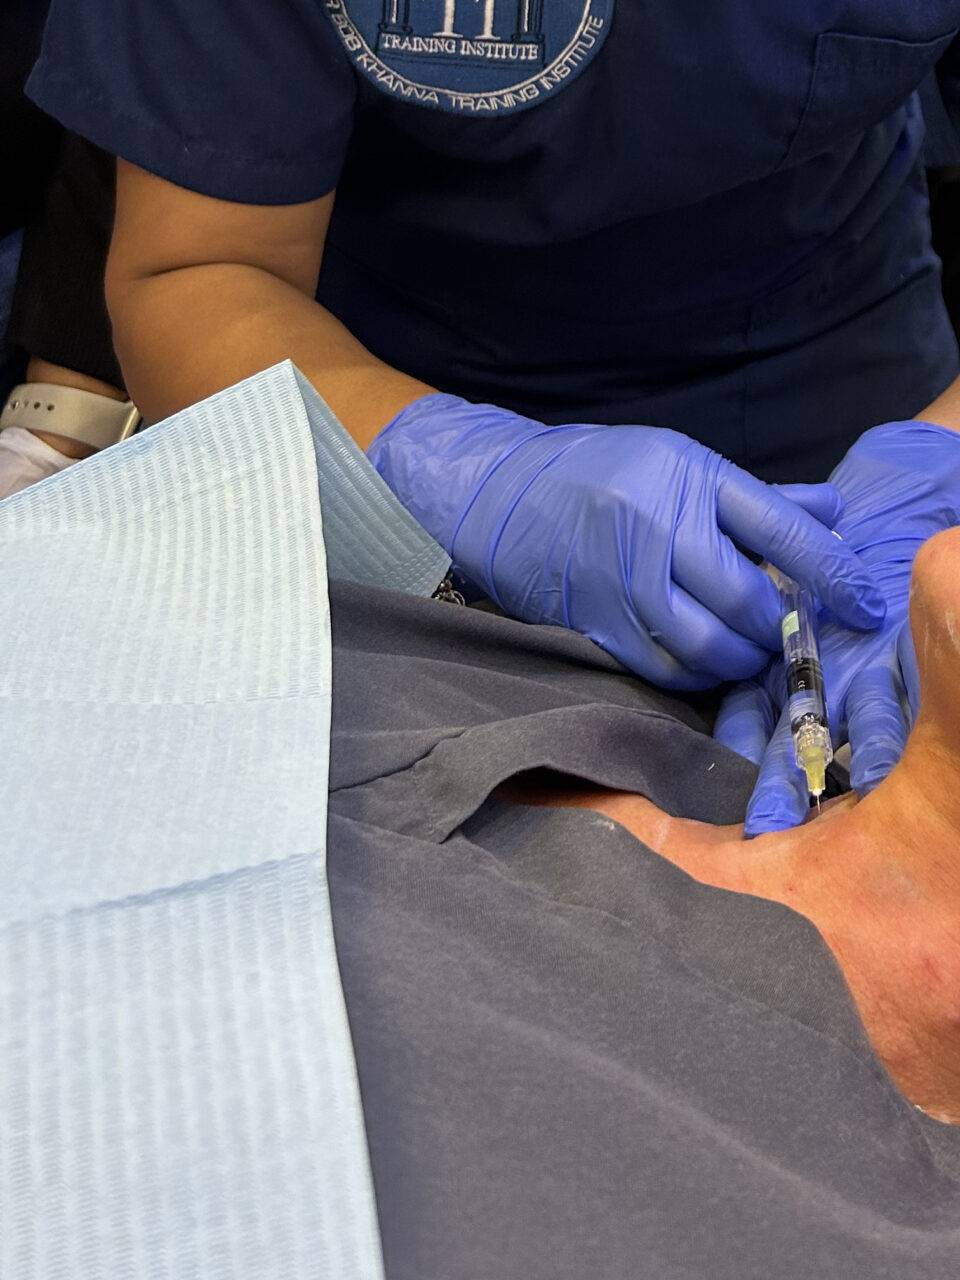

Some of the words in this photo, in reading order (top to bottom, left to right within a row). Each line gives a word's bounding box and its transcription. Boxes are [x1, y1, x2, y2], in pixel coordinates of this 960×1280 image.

[357, 53, 439, 104] KHANNA
[448, 84, 540, 111] TRAINING
[540, 15, 604, 90] INSTITUTE
[382, 33, 456, 54] TRAINING
[461, 40, 538, 61] INSTITUTE
